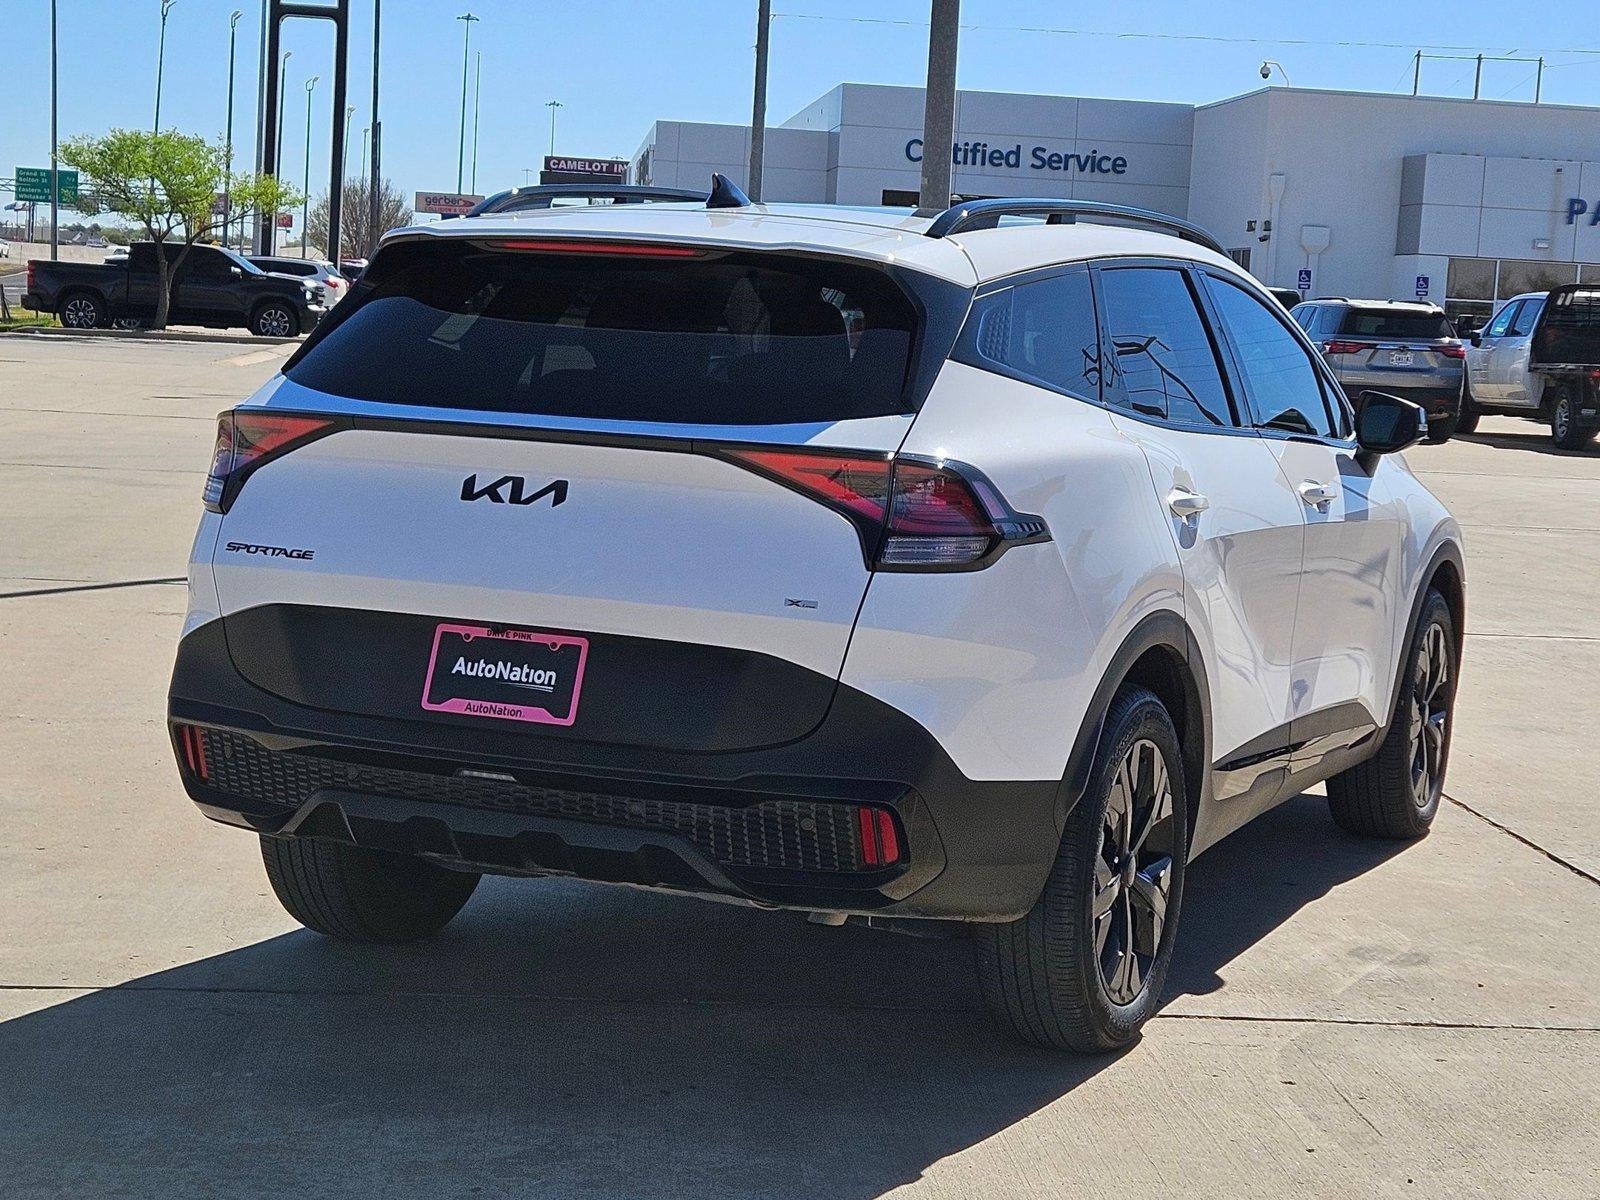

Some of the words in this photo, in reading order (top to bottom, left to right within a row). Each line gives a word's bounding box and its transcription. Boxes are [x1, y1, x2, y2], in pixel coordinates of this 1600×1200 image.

[905, 138, 1021, 168] Ctified
[1031, 146, 1128, 175] Service
[550, 160, 609, 172] CAMELOT
[425, 196, 461, 206] gerber
[460, 474, 569, 508] KIA
[225, 541, 315, 561] SPORTAGE
[512, 631, 533, 640] PINK
[451, 656, 557, 686] AutoNation
[464, 702, 523, 718] AutoNation
